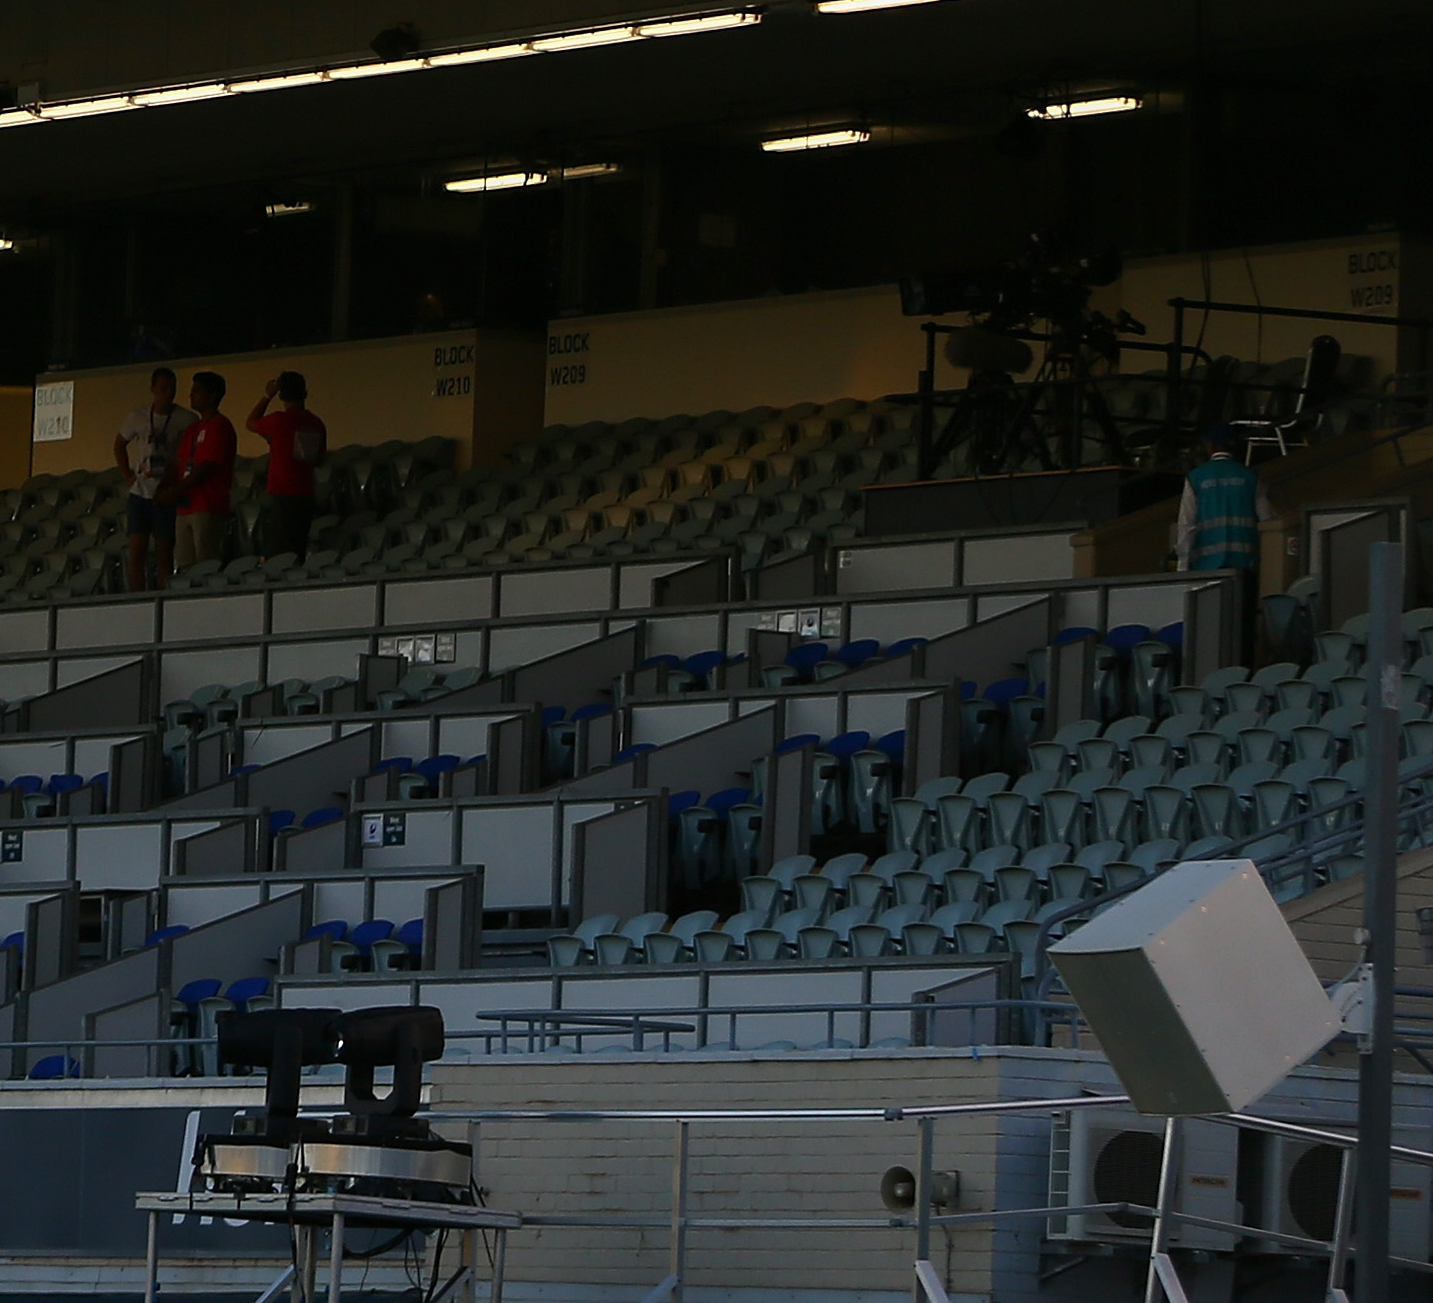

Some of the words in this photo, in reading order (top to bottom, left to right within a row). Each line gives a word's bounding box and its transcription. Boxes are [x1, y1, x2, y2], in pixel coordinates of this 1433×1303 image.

[1348, 251, 1397, 274] BLOCK
[1351, 284, 1393, 307] W209
[549, 332, 590, 355] BLOCK
[434, 345, 474, 367] BLOCK
[550, 365, 586, 386] W209
[36, 387, 73, 406] BLOCK
[436, 376, 471, 397] W210
[36, 415, 70, 435] W210
